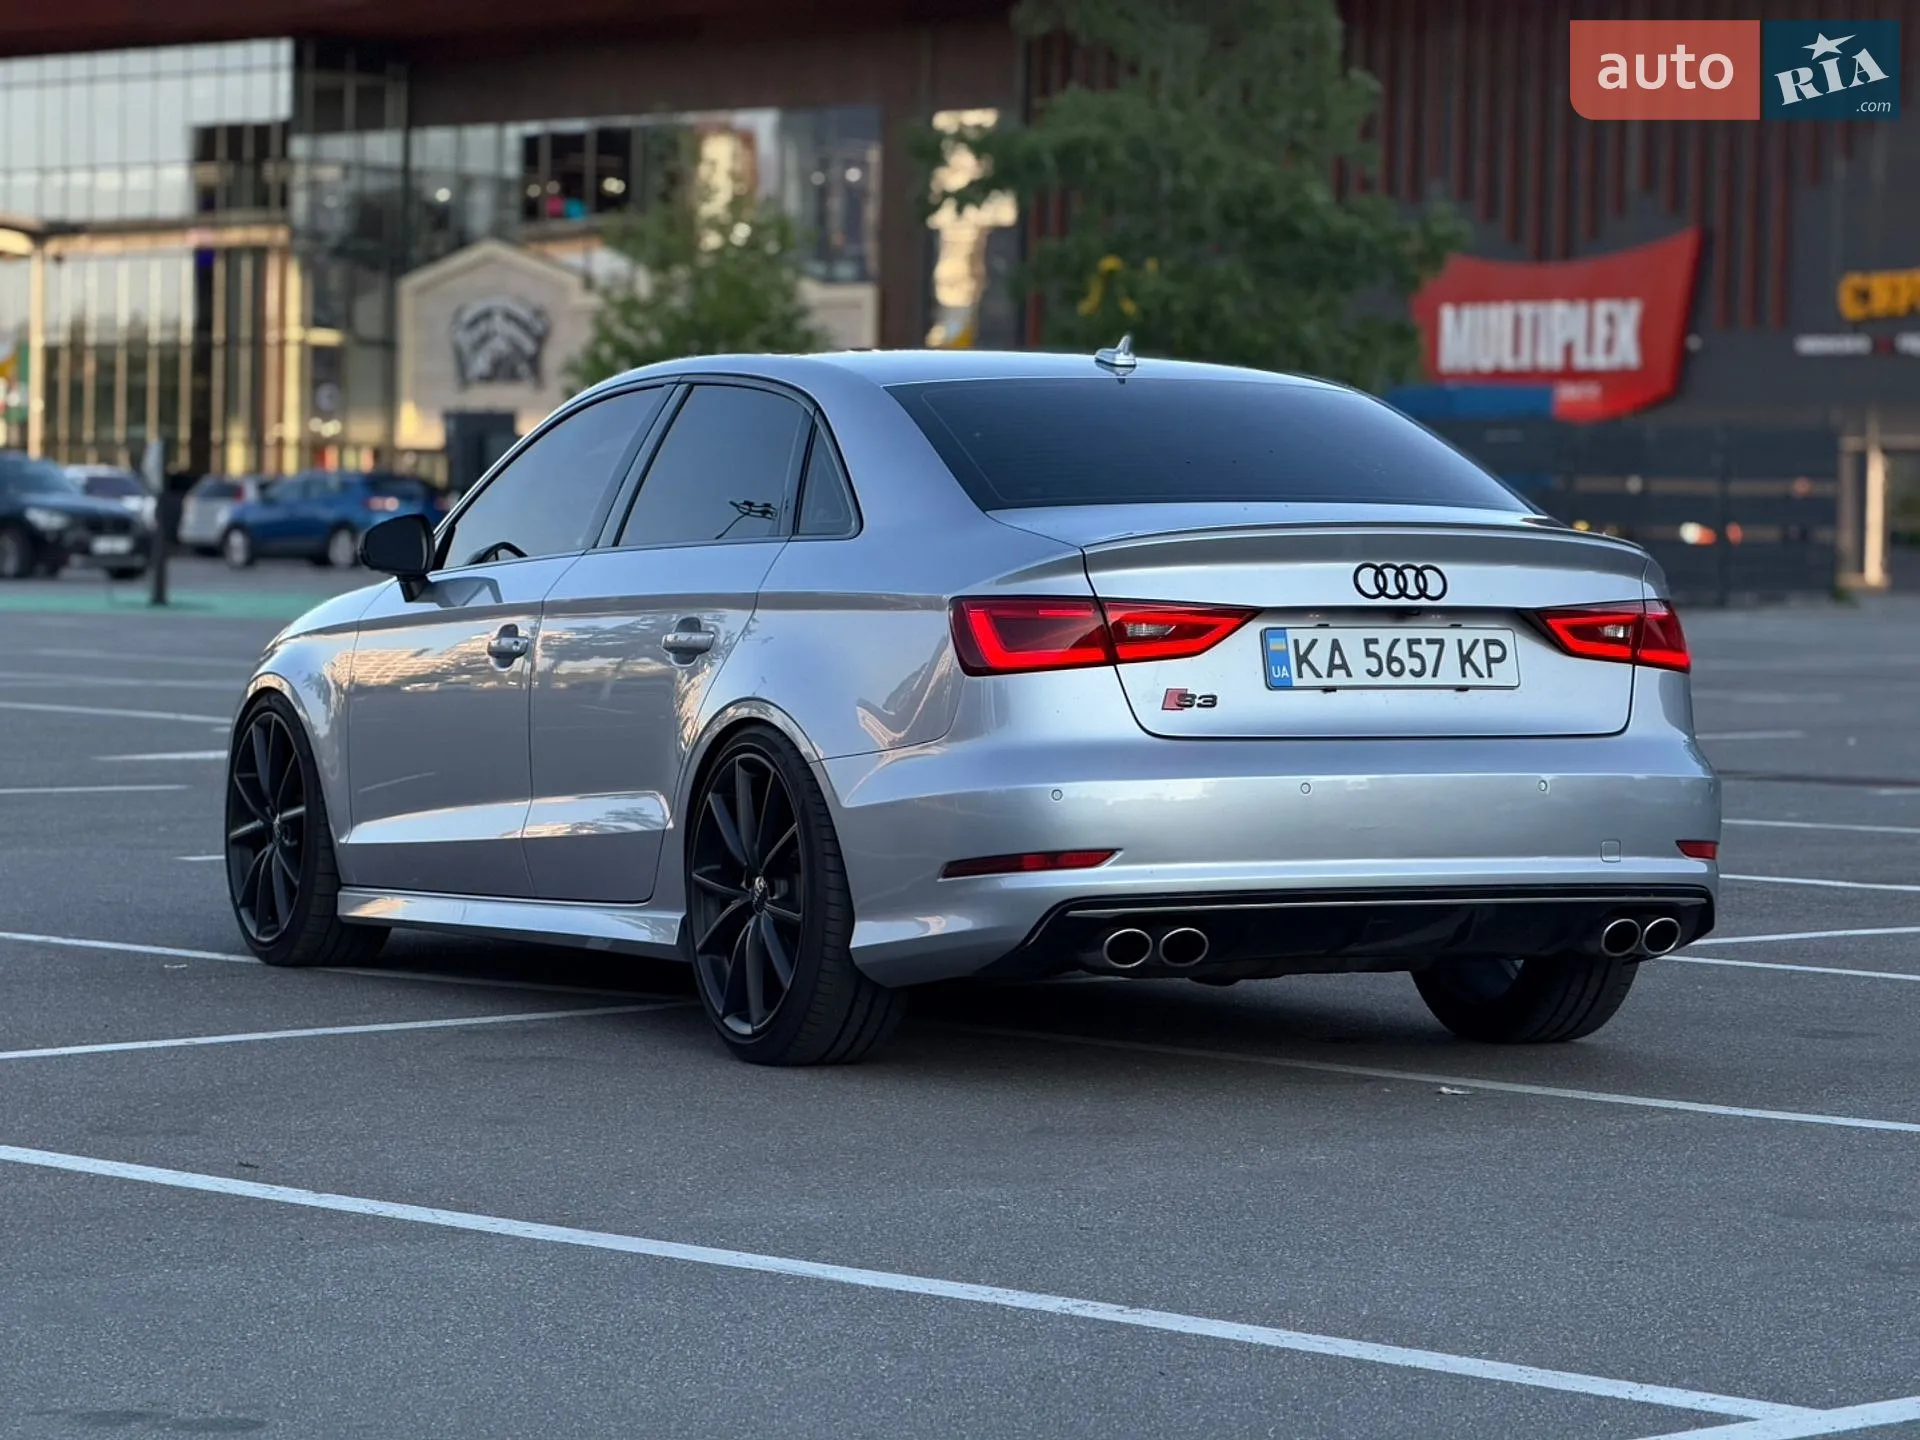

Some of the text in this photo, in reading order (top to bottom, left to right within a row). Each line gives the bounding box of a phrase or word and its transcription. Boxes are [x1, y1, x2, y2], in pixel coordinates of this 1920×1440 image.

[1438, 298, 1643, 373] MULTIPLEX
[1271, 665, 1290, 678] UA
[1293, 637, 1508, 679] KA 5657 KP
[1175, 693, 1218, 708] S3
